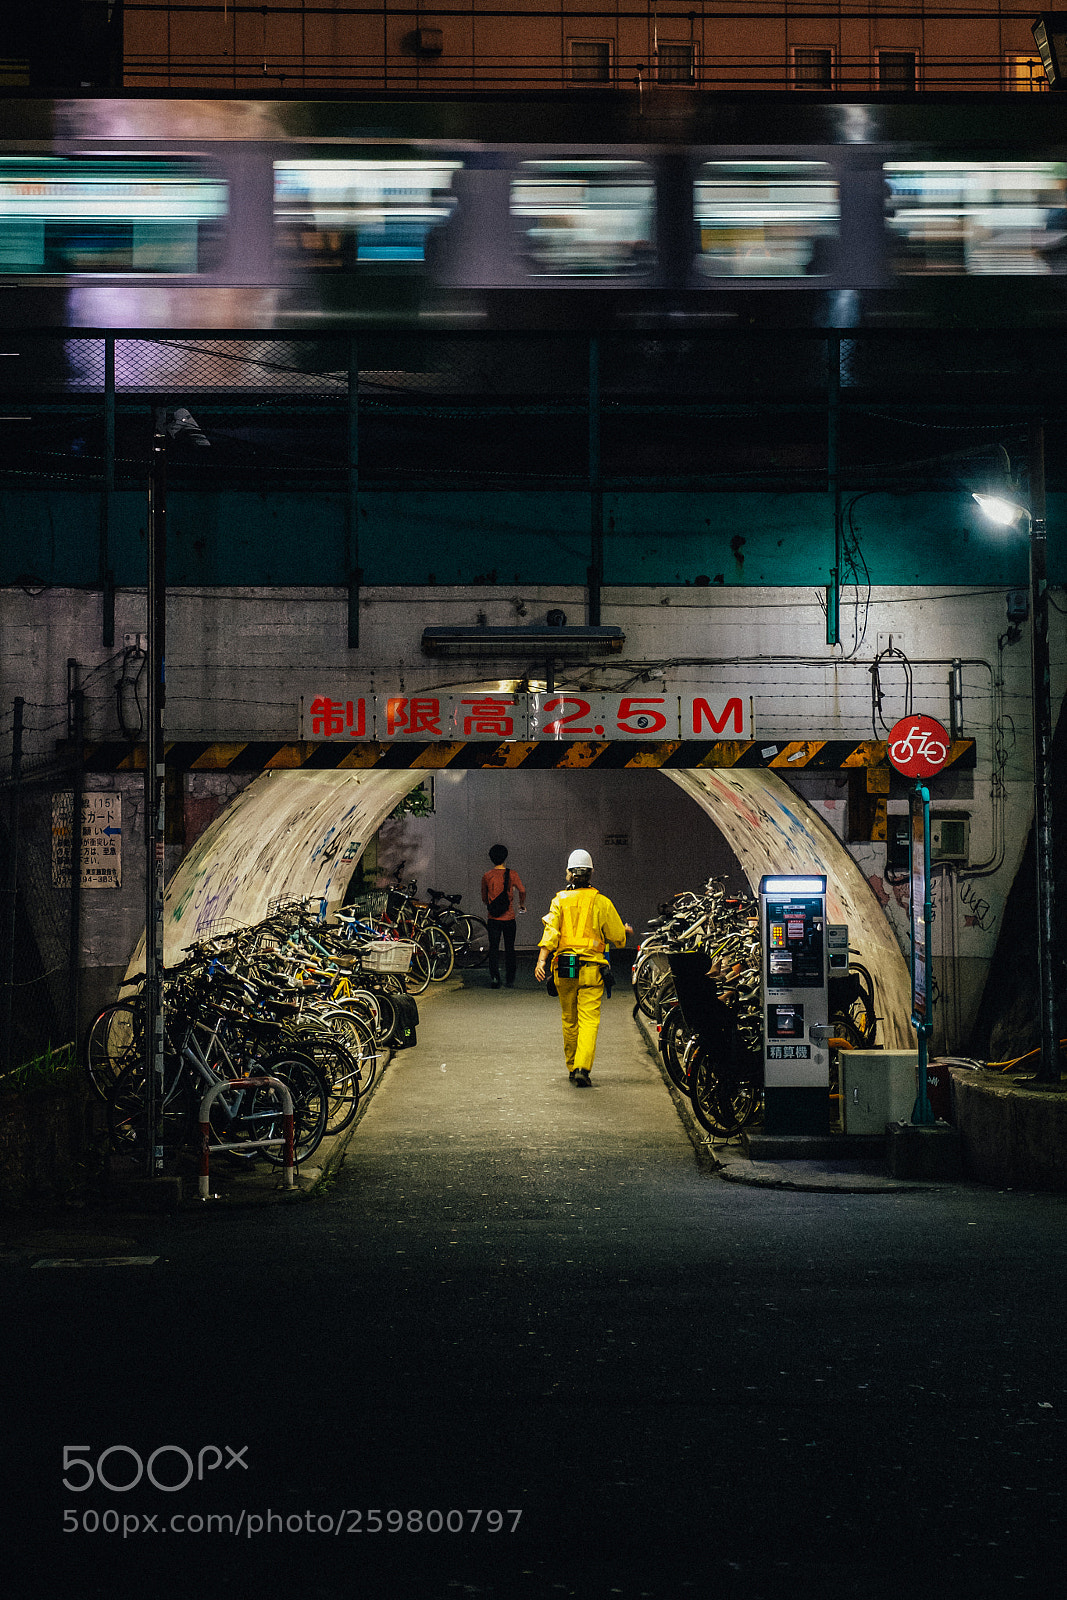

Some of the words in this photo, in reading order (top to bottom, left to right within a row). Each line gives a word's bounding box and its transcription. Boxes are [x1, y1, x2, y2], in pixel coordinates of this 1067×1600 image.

[309, 696, 744, 737] 制限高2.5M
[769, 1045, 808, 1059] 精算機
